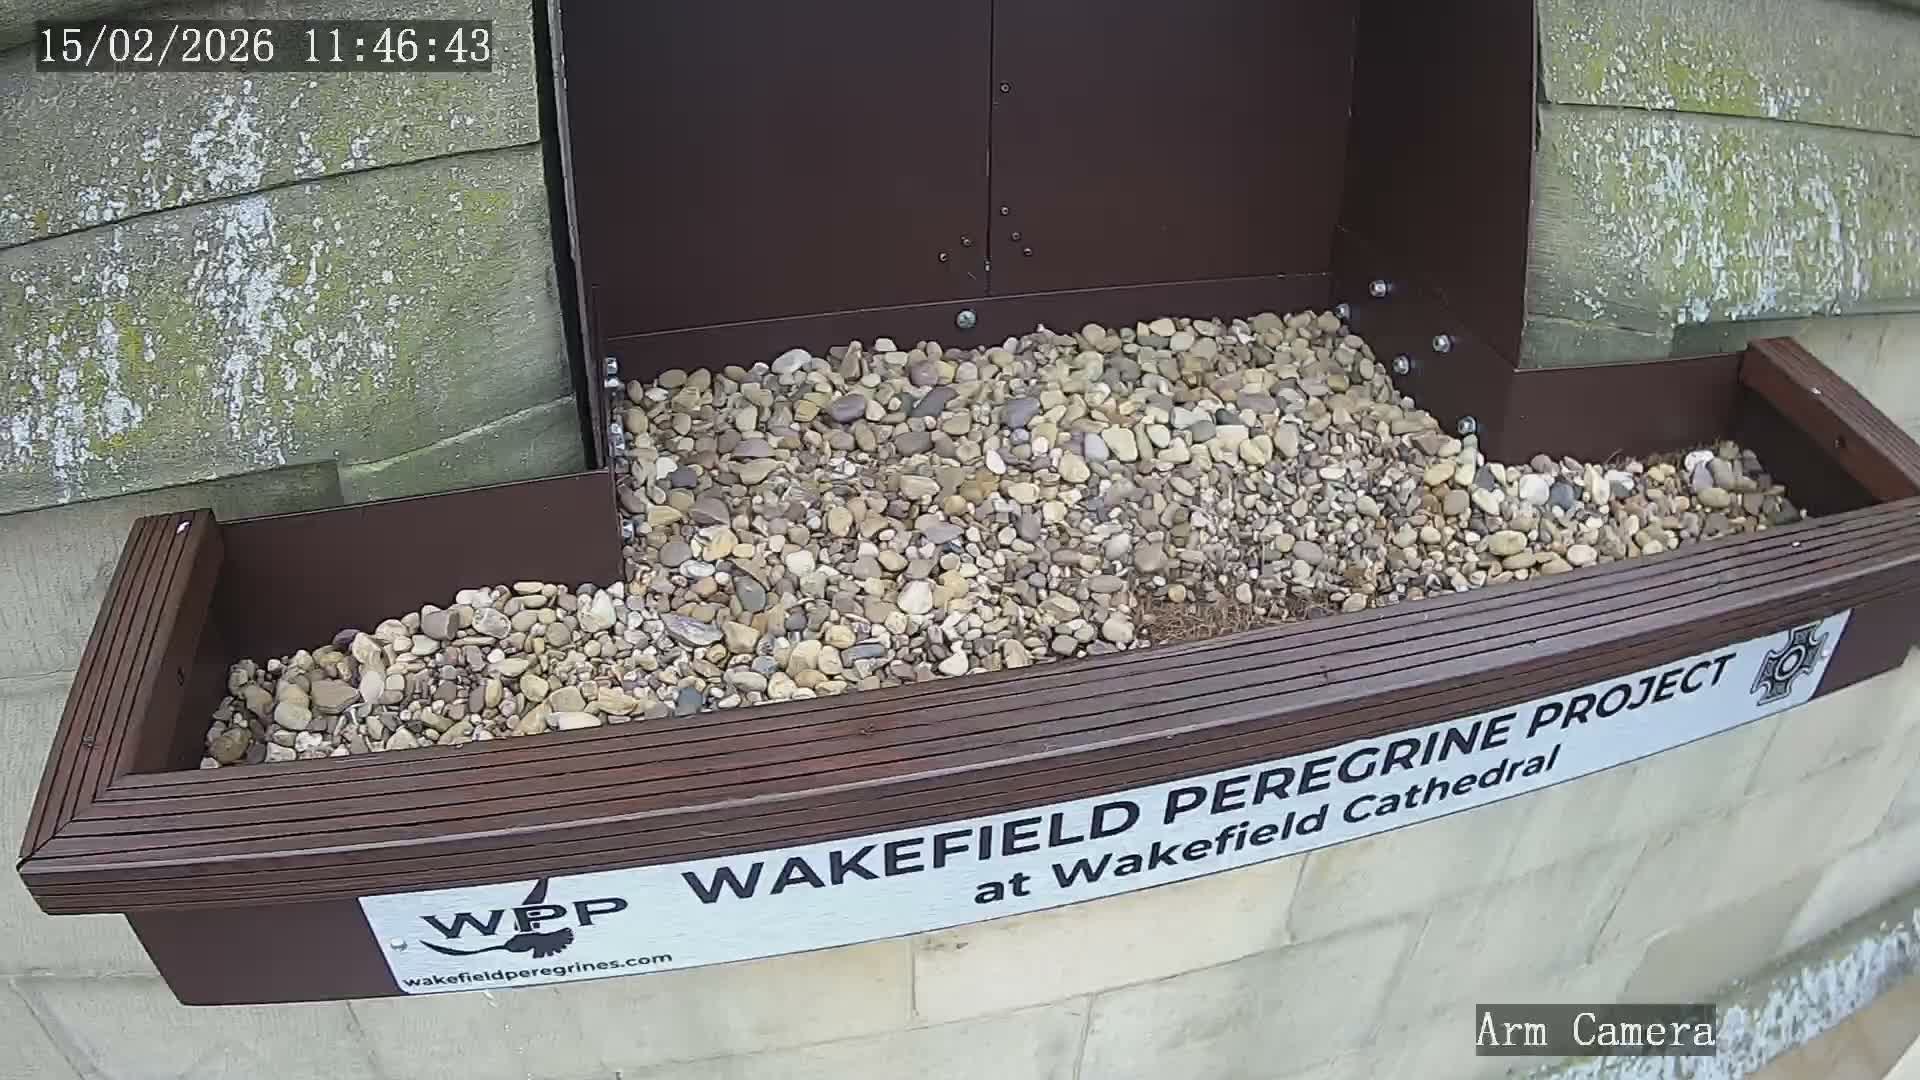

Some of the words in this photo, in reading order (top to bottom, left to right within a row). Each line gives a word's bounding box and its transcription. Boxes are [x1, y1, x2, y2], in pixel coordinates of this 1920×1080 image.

[682, 801, 1141, 904] WAKEFIELD
[1163, 713, 1517, 825] PEREGRINE
[1527, 653, 1737, 738] PROJECT
[974, 873, 1031, 904] at
[1052, 806, 1328, 889] Wakefield
[1343, 745, 1561, 825] Cathedral
[420, 897, 628, 939] WPP
[402, 951, 673, 989] wakefieldperegrines.com
